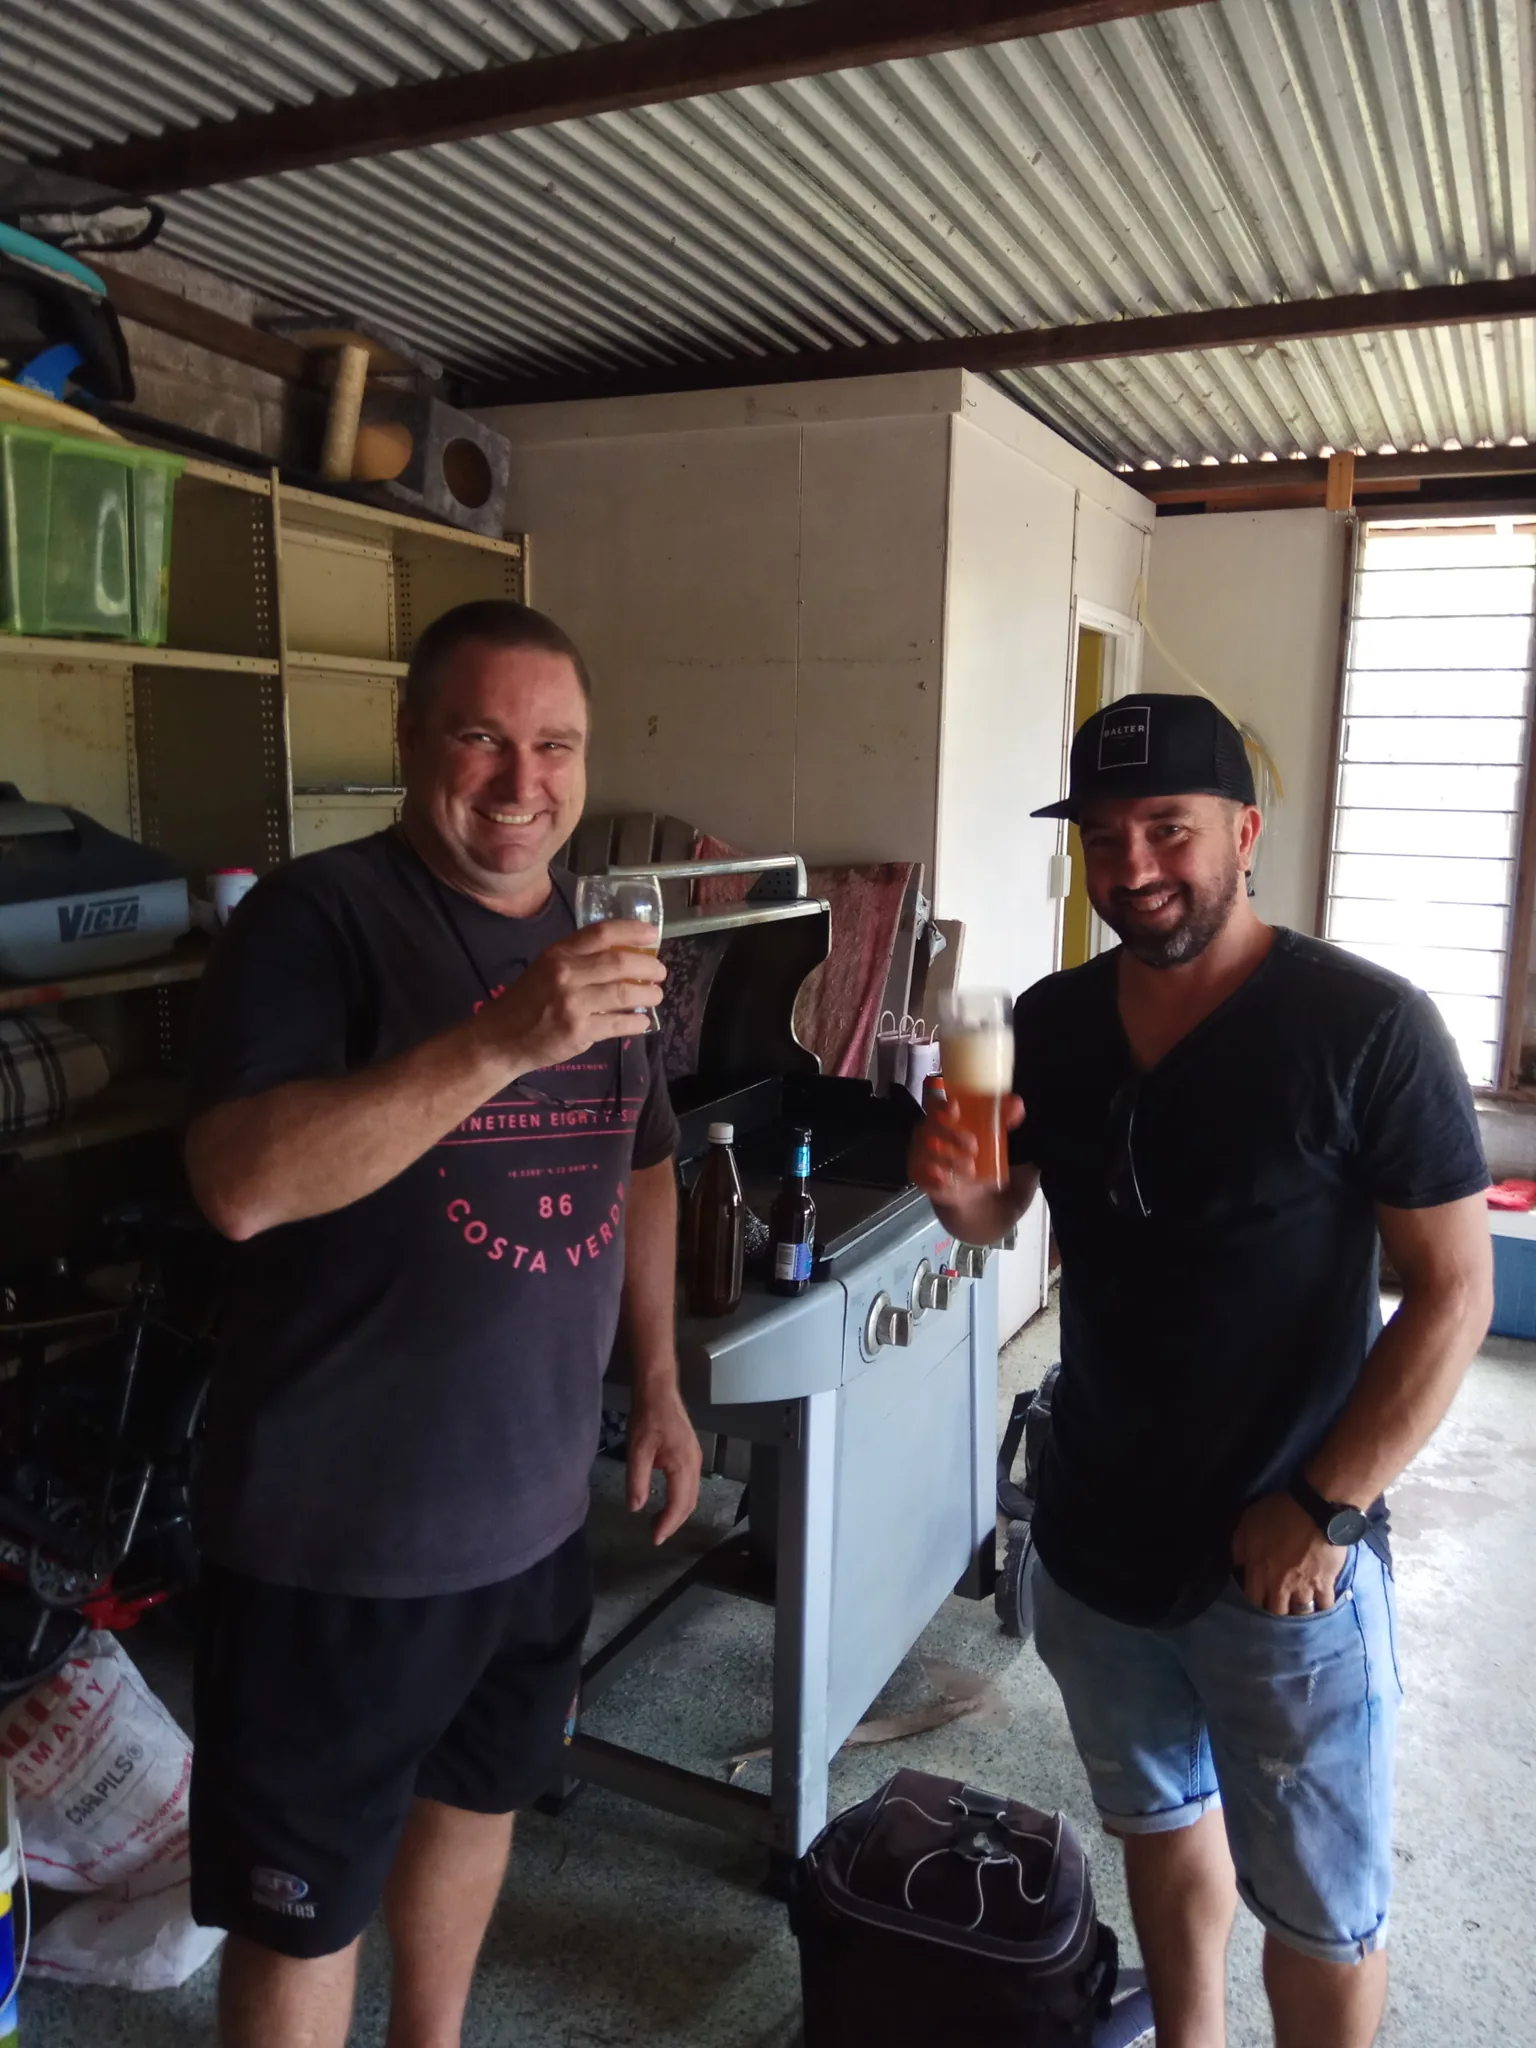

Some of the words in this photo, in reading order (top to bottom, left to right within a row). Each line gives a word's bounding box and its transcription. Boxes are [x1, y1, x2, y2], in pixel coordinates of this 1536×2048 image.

[58, 900, 140, 942] VICTA
[452, 1113, 541, 1132] INETEEN
[539, 1194, 573, 1219] 86
[447, 1198, 548, 1274] COSTA
